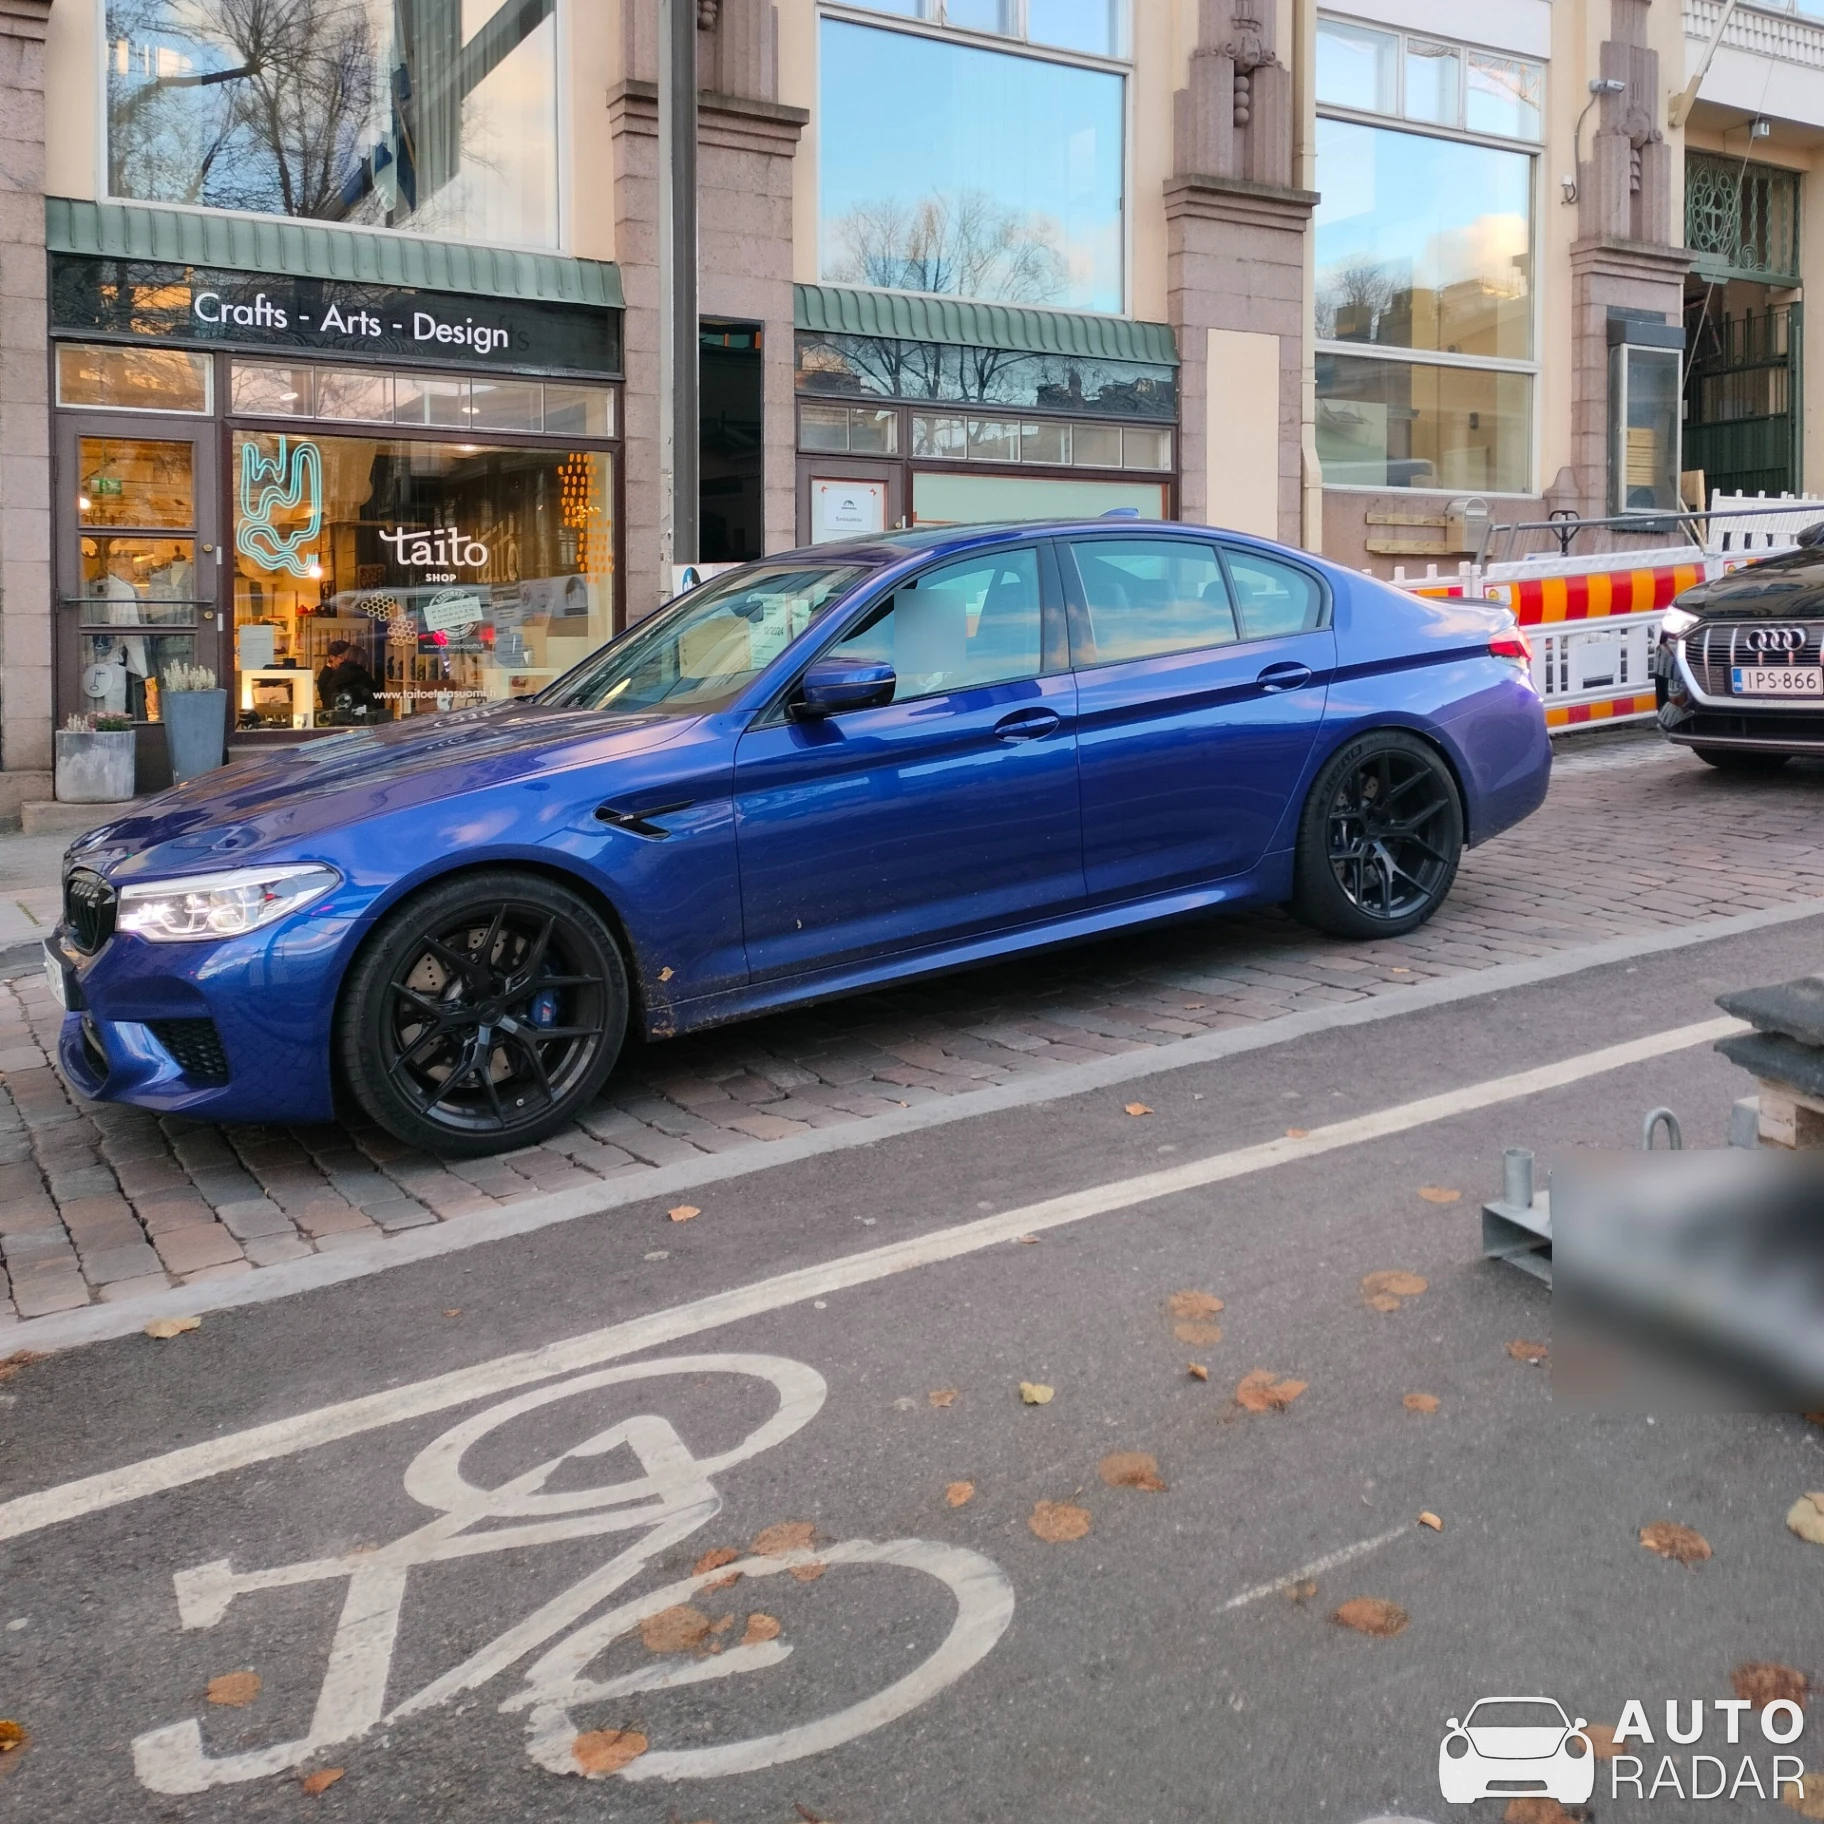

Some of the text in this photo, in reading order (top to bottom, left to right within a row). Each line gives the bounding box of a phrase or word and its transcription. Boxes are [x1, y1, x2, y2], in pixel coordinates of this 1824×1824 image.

[194, 293, 288, 328] Crafts
[320, 304, 382, 337] Arts
[413, 312, 509, 354] Design
[379, 526, 488, 567] taito
[425, 573, 457, 582] SHOP
[1748, 671, 1817, 690] IPS-866
[372, 687, 497, 700] www.taitoetelasuomi.fi
